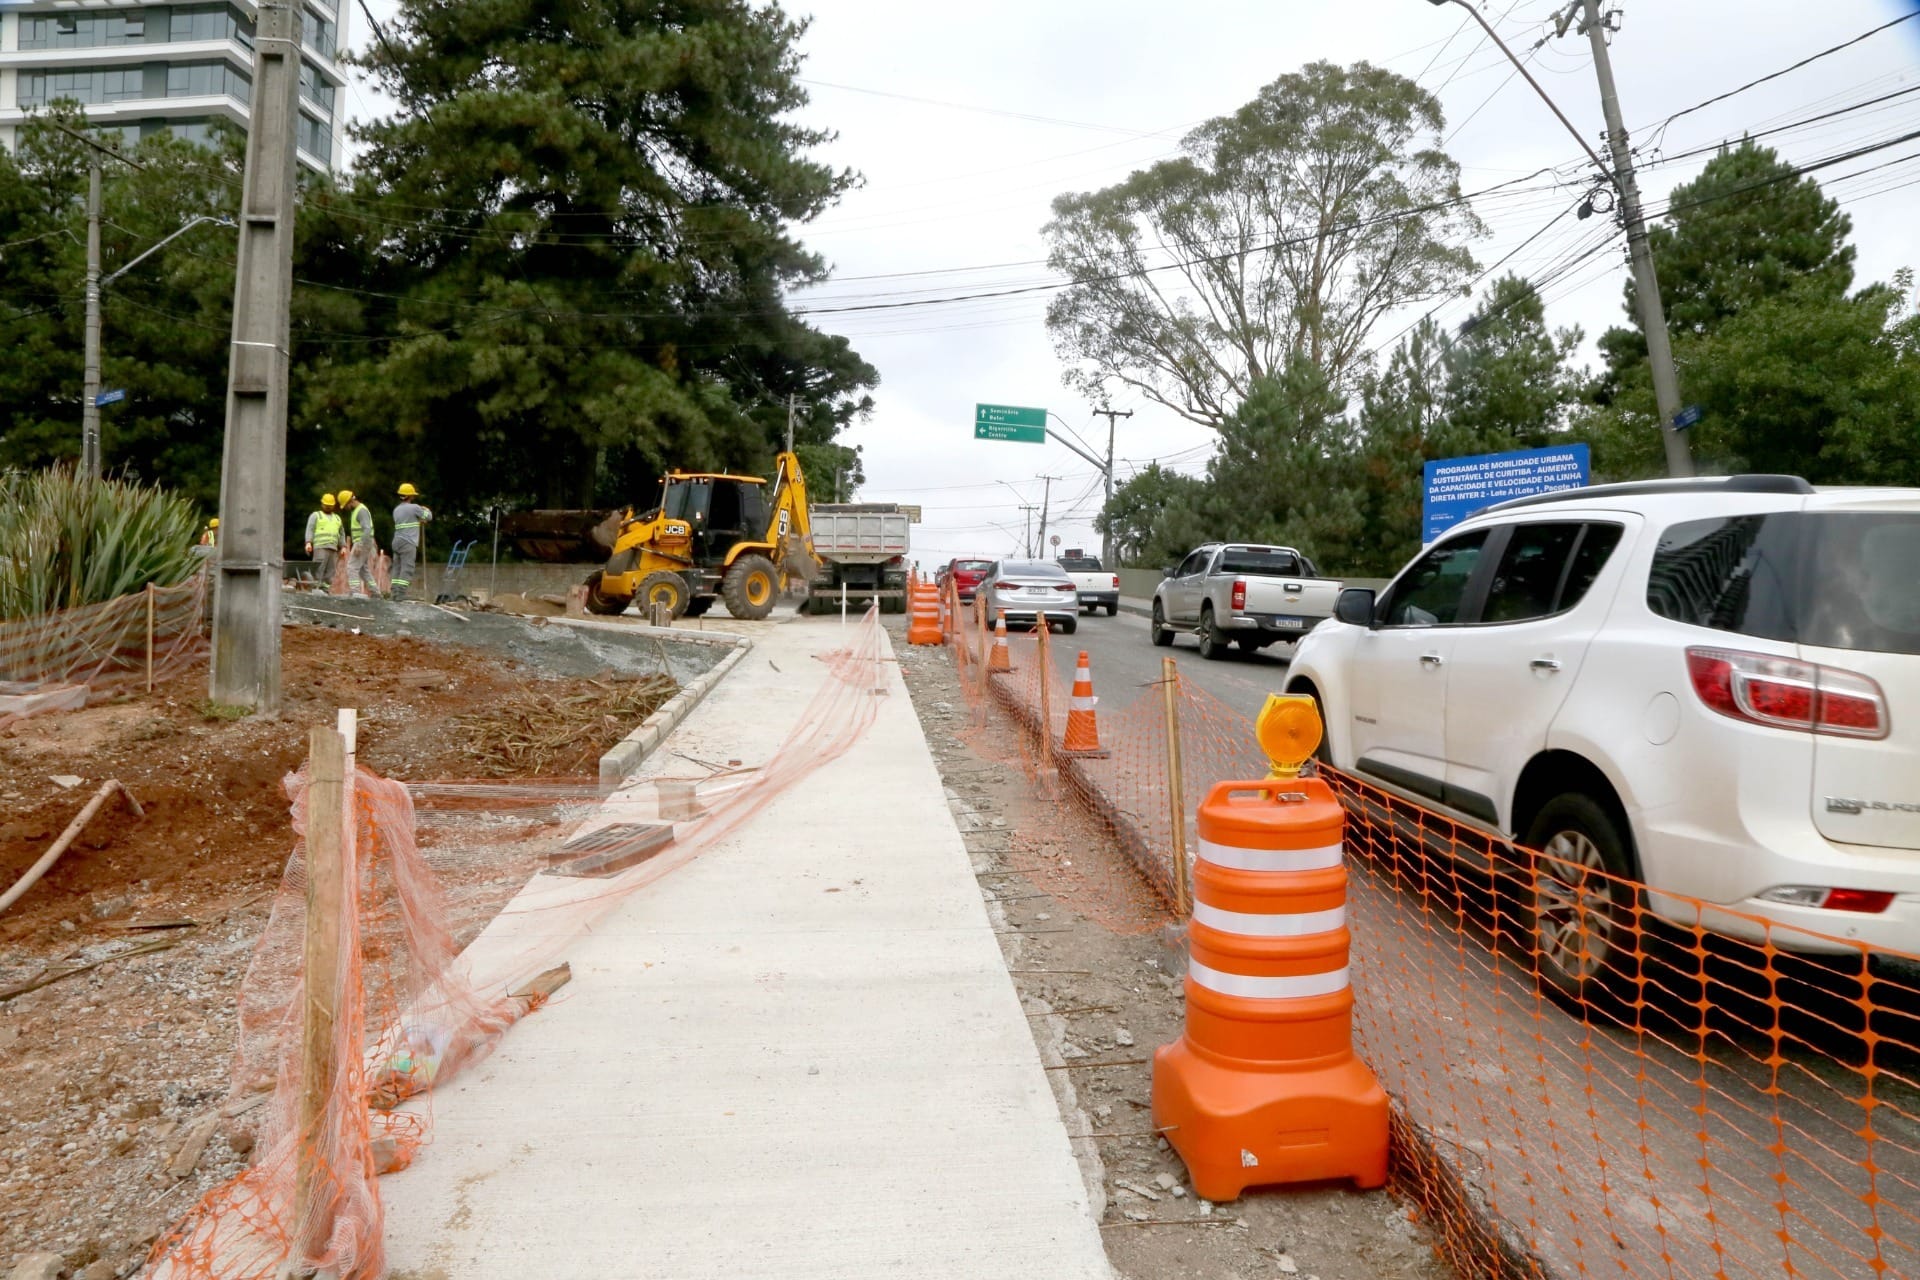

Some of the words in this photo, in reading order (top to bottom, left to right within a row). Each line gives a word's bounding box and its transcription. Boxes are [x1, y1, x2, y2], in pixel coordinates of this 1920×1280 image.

[1432, 473, 1483, 485] SUSTENTÁVEL
[1495, 468, 1531, 478] CURITIBA
[1537, 463, 1578, 474] AUMENTO
[1436, 464, 1478, 475] PROGRAMA
[1479, 462, 1490, 470] DE
[1491, 457, 1540, 469] MOBILIDADE
[1540, 453, 1574, 464] URBANA
[1440, 481, 1486, 492] CAPACIDADE
[1493, 476, 1543, 487] VELOCIDADE
[1556, 472, 1582, 481] LINHA
[1430, 494, 1456, 503] DIRETA
[1457, 491, 1479, 500] INTER
[1515, 487, 1534, 496] (Lote
[664, 524, 686, 535] JCB
[778, 509, 789, 538] CB
